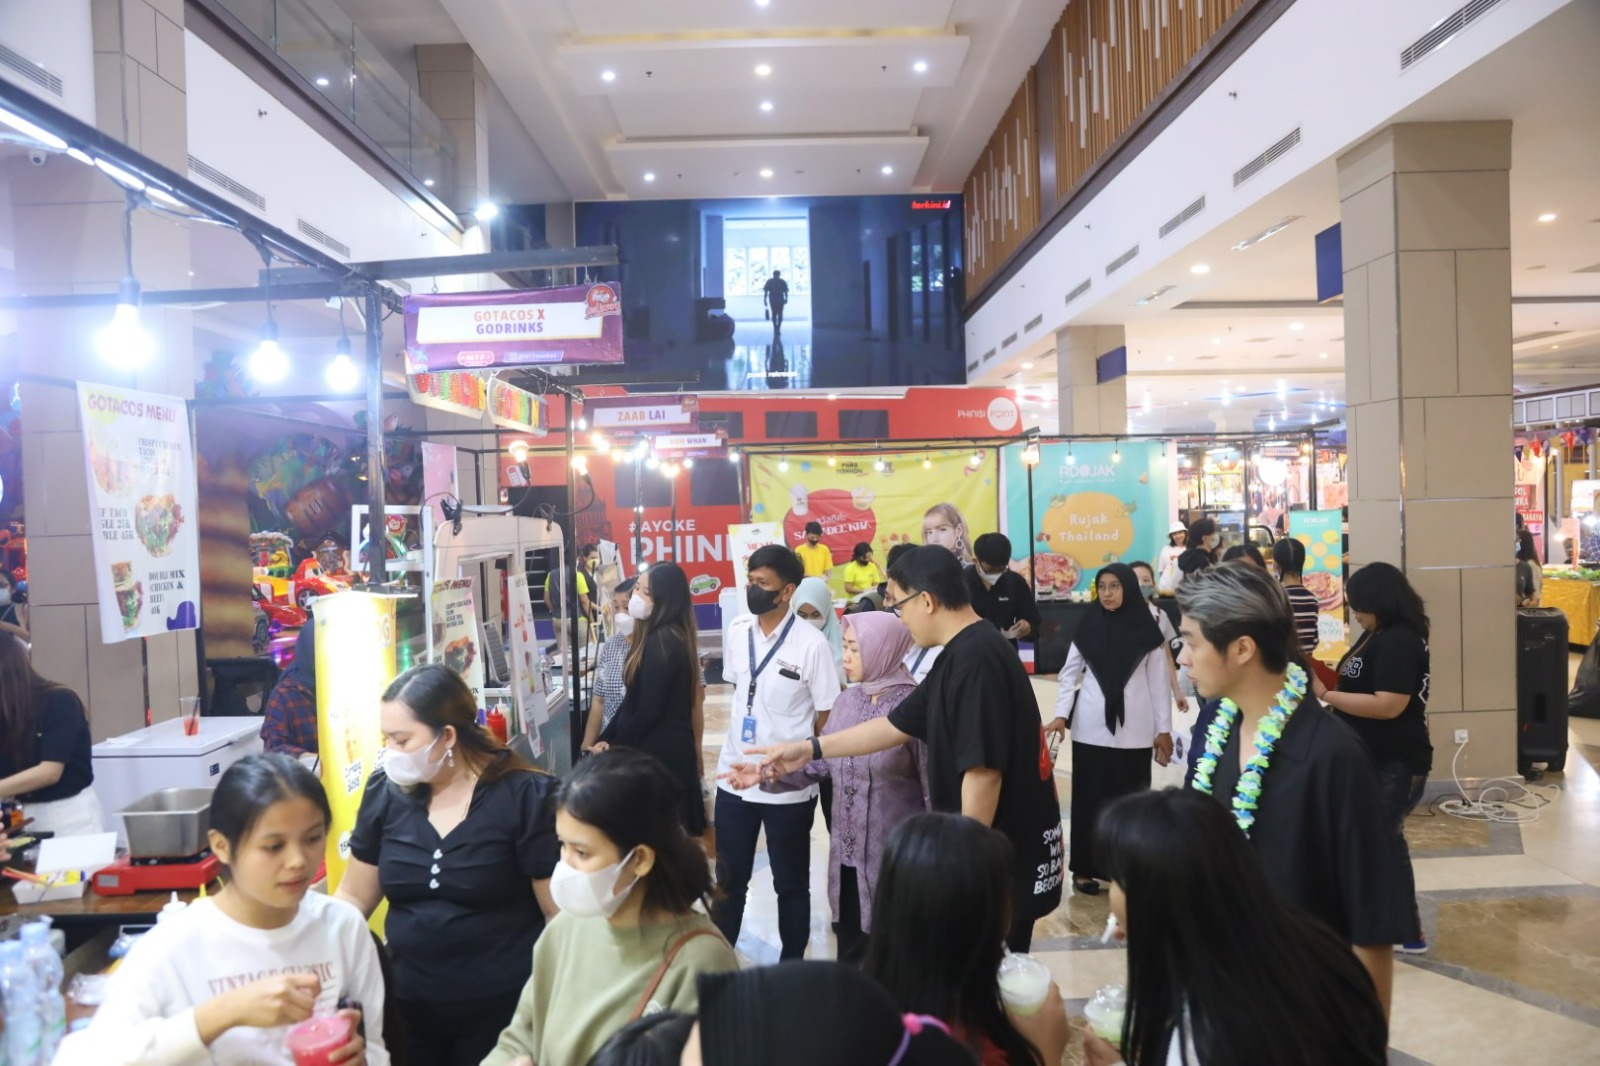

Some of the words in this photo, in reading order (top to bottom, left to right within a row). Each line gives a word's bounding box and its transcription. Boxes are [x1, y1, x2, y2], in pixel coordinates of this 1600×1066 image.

[474, 309, 533, 322] GOTACOS
[537, 308, 546, 321] X
[476, 322, 544, 335] GODRINKS
[87, 393, 144, 418] GOTACOS
[145, 403, 176, 423] MENU
[957, 409, 986, 418] PHINISI
[990, 409, 1015, 419] POINT
[617, 410, 646, 422] ZAAB
[648, 409, 666, 421] LAI
[1059, 464, 1116, 478] ROOJAK
[628, 518, 697, 533] #AYOKE
[1069, 511, 1108, 529] Rujak
[1058, 528, 1120, 542] Thailand
[169, 569, 185, 579] MIX
[176, 580, 184, 590] &
[450, 579, 472, 590] MENU
[1037, 863, 1050, 879] SO
